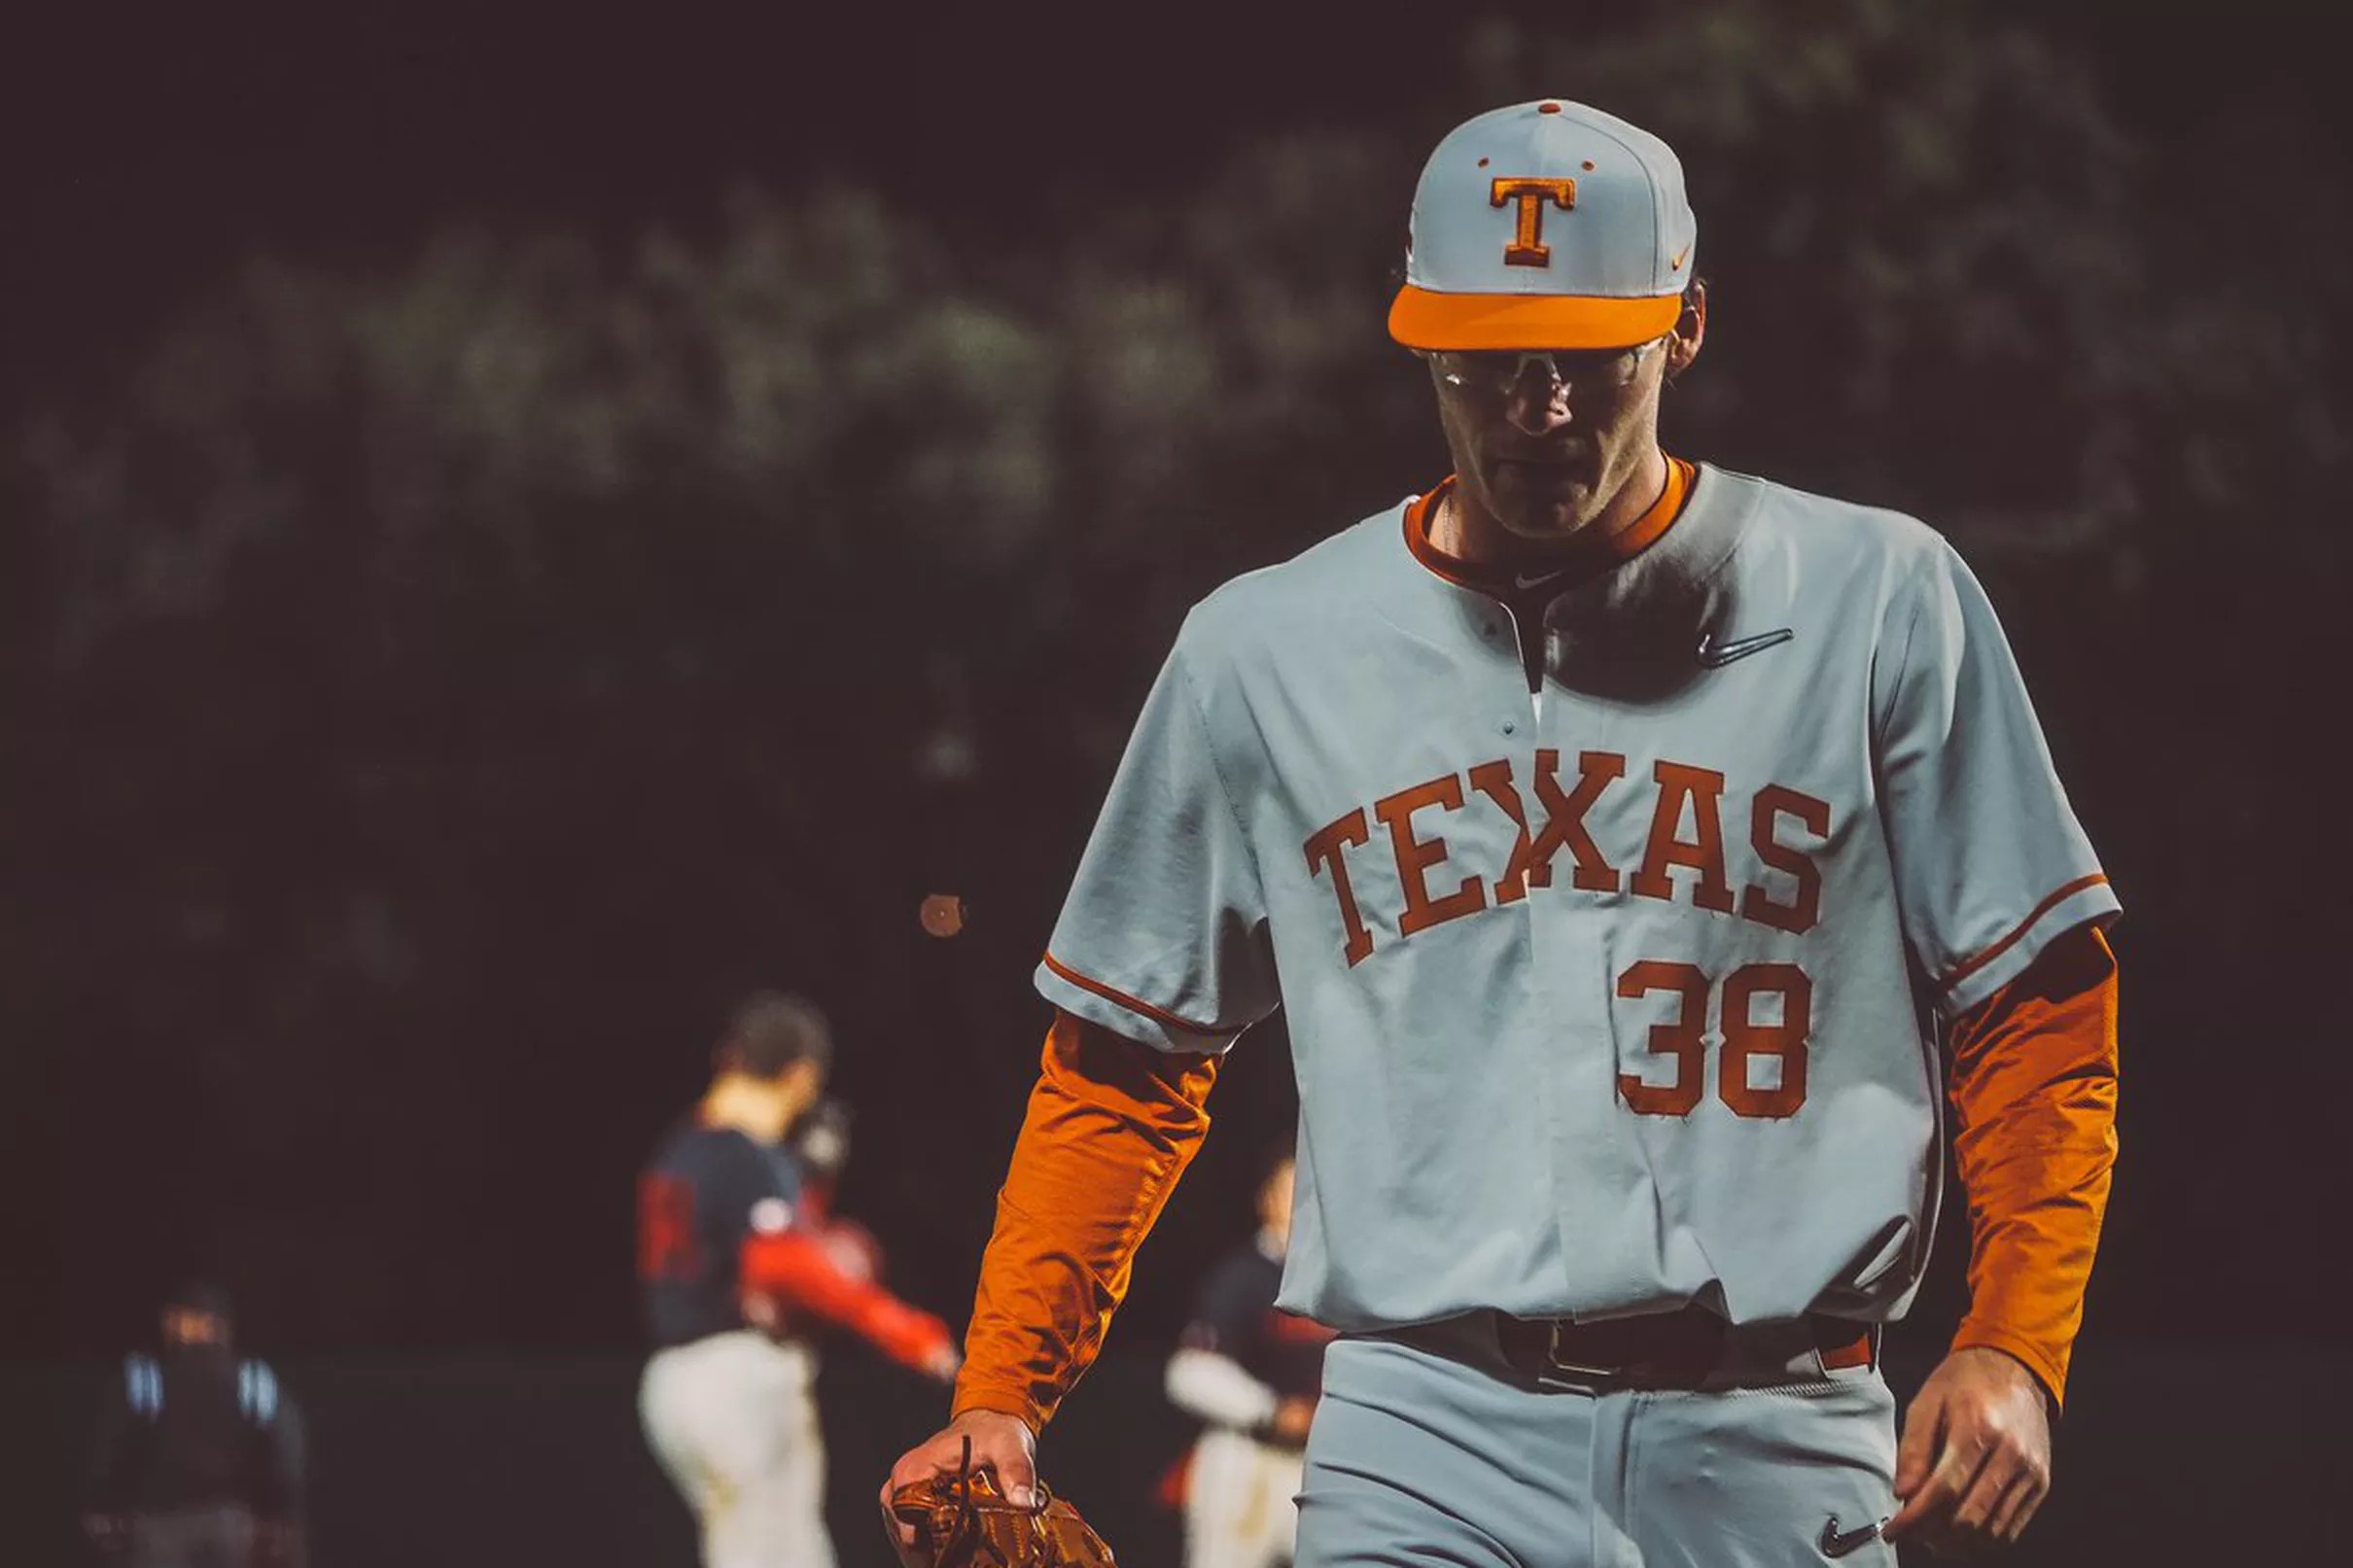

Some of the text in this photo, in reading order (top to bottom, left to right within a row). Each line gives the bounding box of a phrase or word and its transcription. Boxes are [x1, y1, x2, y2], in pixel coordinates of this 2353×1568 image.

[1490, 177, 1576, 267] T
[1302, 748, 1831, 970] TEXAS
[1616, 959, 1813, 1119] 38
